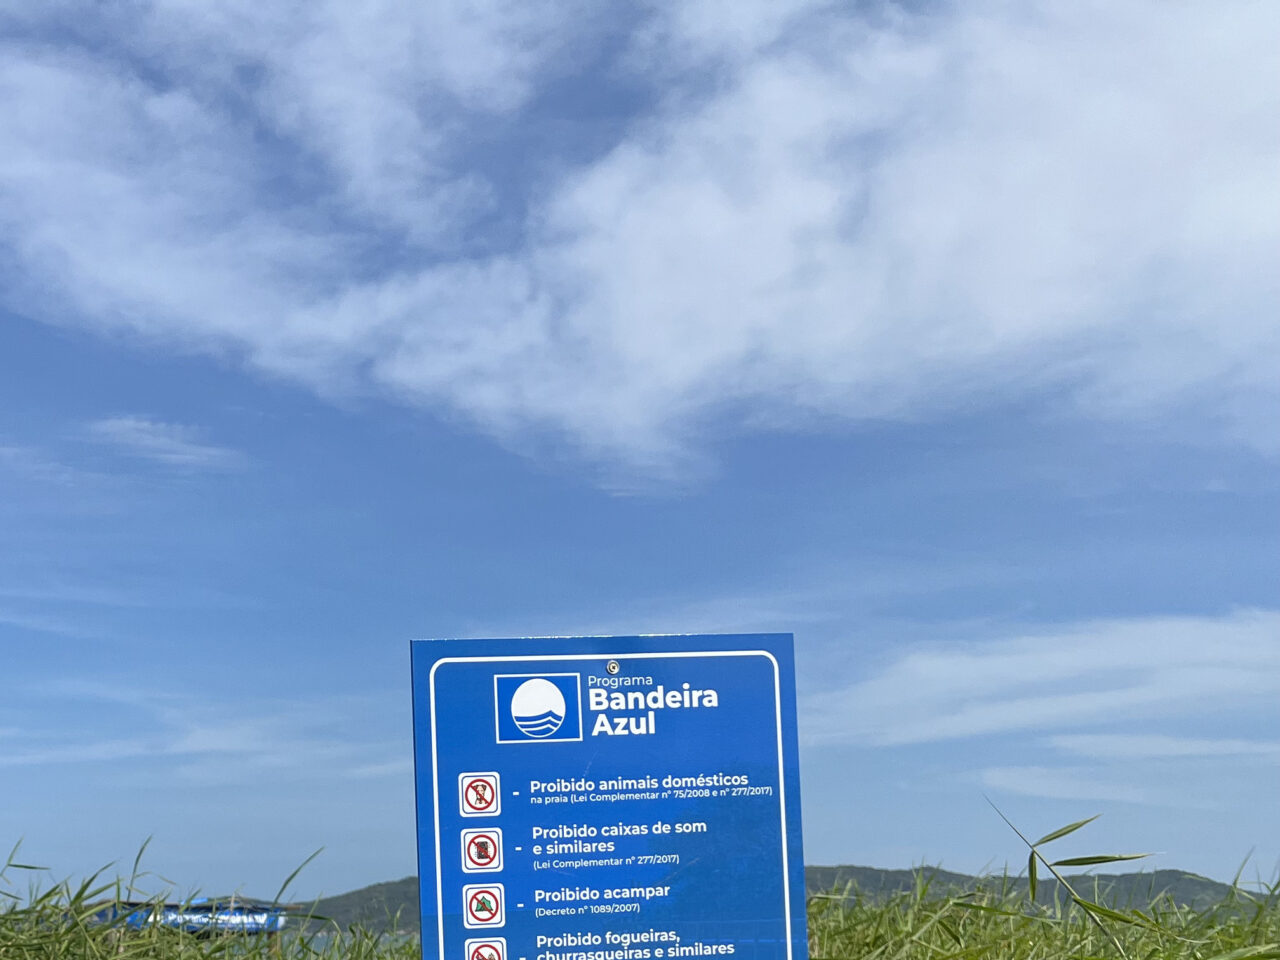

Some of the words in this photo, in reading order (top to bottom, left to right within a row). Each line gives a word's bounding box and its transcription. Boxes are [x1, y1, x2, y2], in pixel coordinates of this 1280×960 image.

[588, 675, 653, 688] Programa
[589, 683, 718, 710] Bandeira
[591, 710, 655, 736] Azul
[530, 777, 595, 793] Proibido
[598, 775, 659, 790] animais
[661, 772, 749, 788] domésticos
[530, 796, 542, 804] na
[544, 794, 568, 805] praia
[570, 793, 587, 804] (Lei
[589, 792, 660, 802] Complementar
[673, 788, 710, 798] 75/2008
[731, 786, 772, 796] 277/2017)
[532, 823, 597, 839] Proibido
[600, 821, 648, 836] caixas
[651, 820, 671, 834] de
[674, 822, 707, 833] som
[532, 844, 542, 855] e
[546, 839, 615, 854] similares
[533, 859, 550, 871] (Lei
[552, 858, 623, 869] Complementar
[637, 854, 679, 864] 277/2017)
[534, 886, 600, 902] Proibido
[603, 886, 670, 900] acampar
[535, 907, 576, 918] (Decreto
[589, 902, 640, 914] 1089/2007)
[536, 932, 602, 948] Proibido
[604, 928, 680, 948] fogueiras,
[654, 948, 664, 958] e
[667, 942, 735, 957] similares
